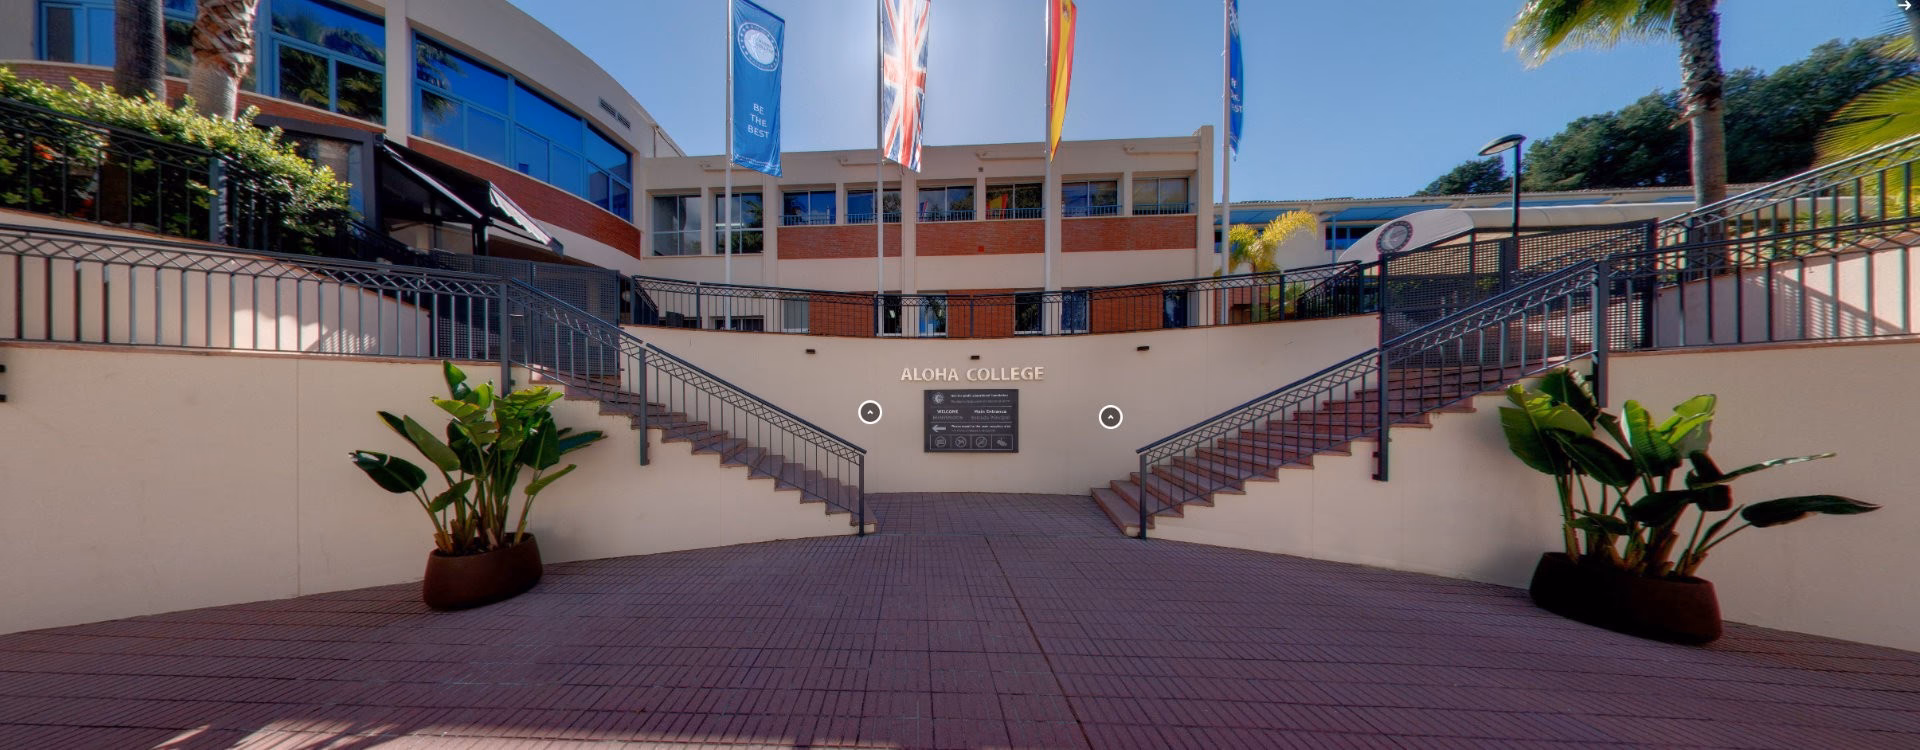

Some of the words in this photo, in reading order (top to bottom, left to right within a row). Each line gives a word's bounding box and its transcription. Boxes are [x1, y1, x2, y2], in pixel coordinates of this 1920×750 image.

[753, 103, 764, 115] BE
[750, 113, 767, 128] THE
[747, 124, 769, 139] BEST
[900, 367, 959, 381] ALOHA
[966, 366, 1045, 381] COLLEGE
